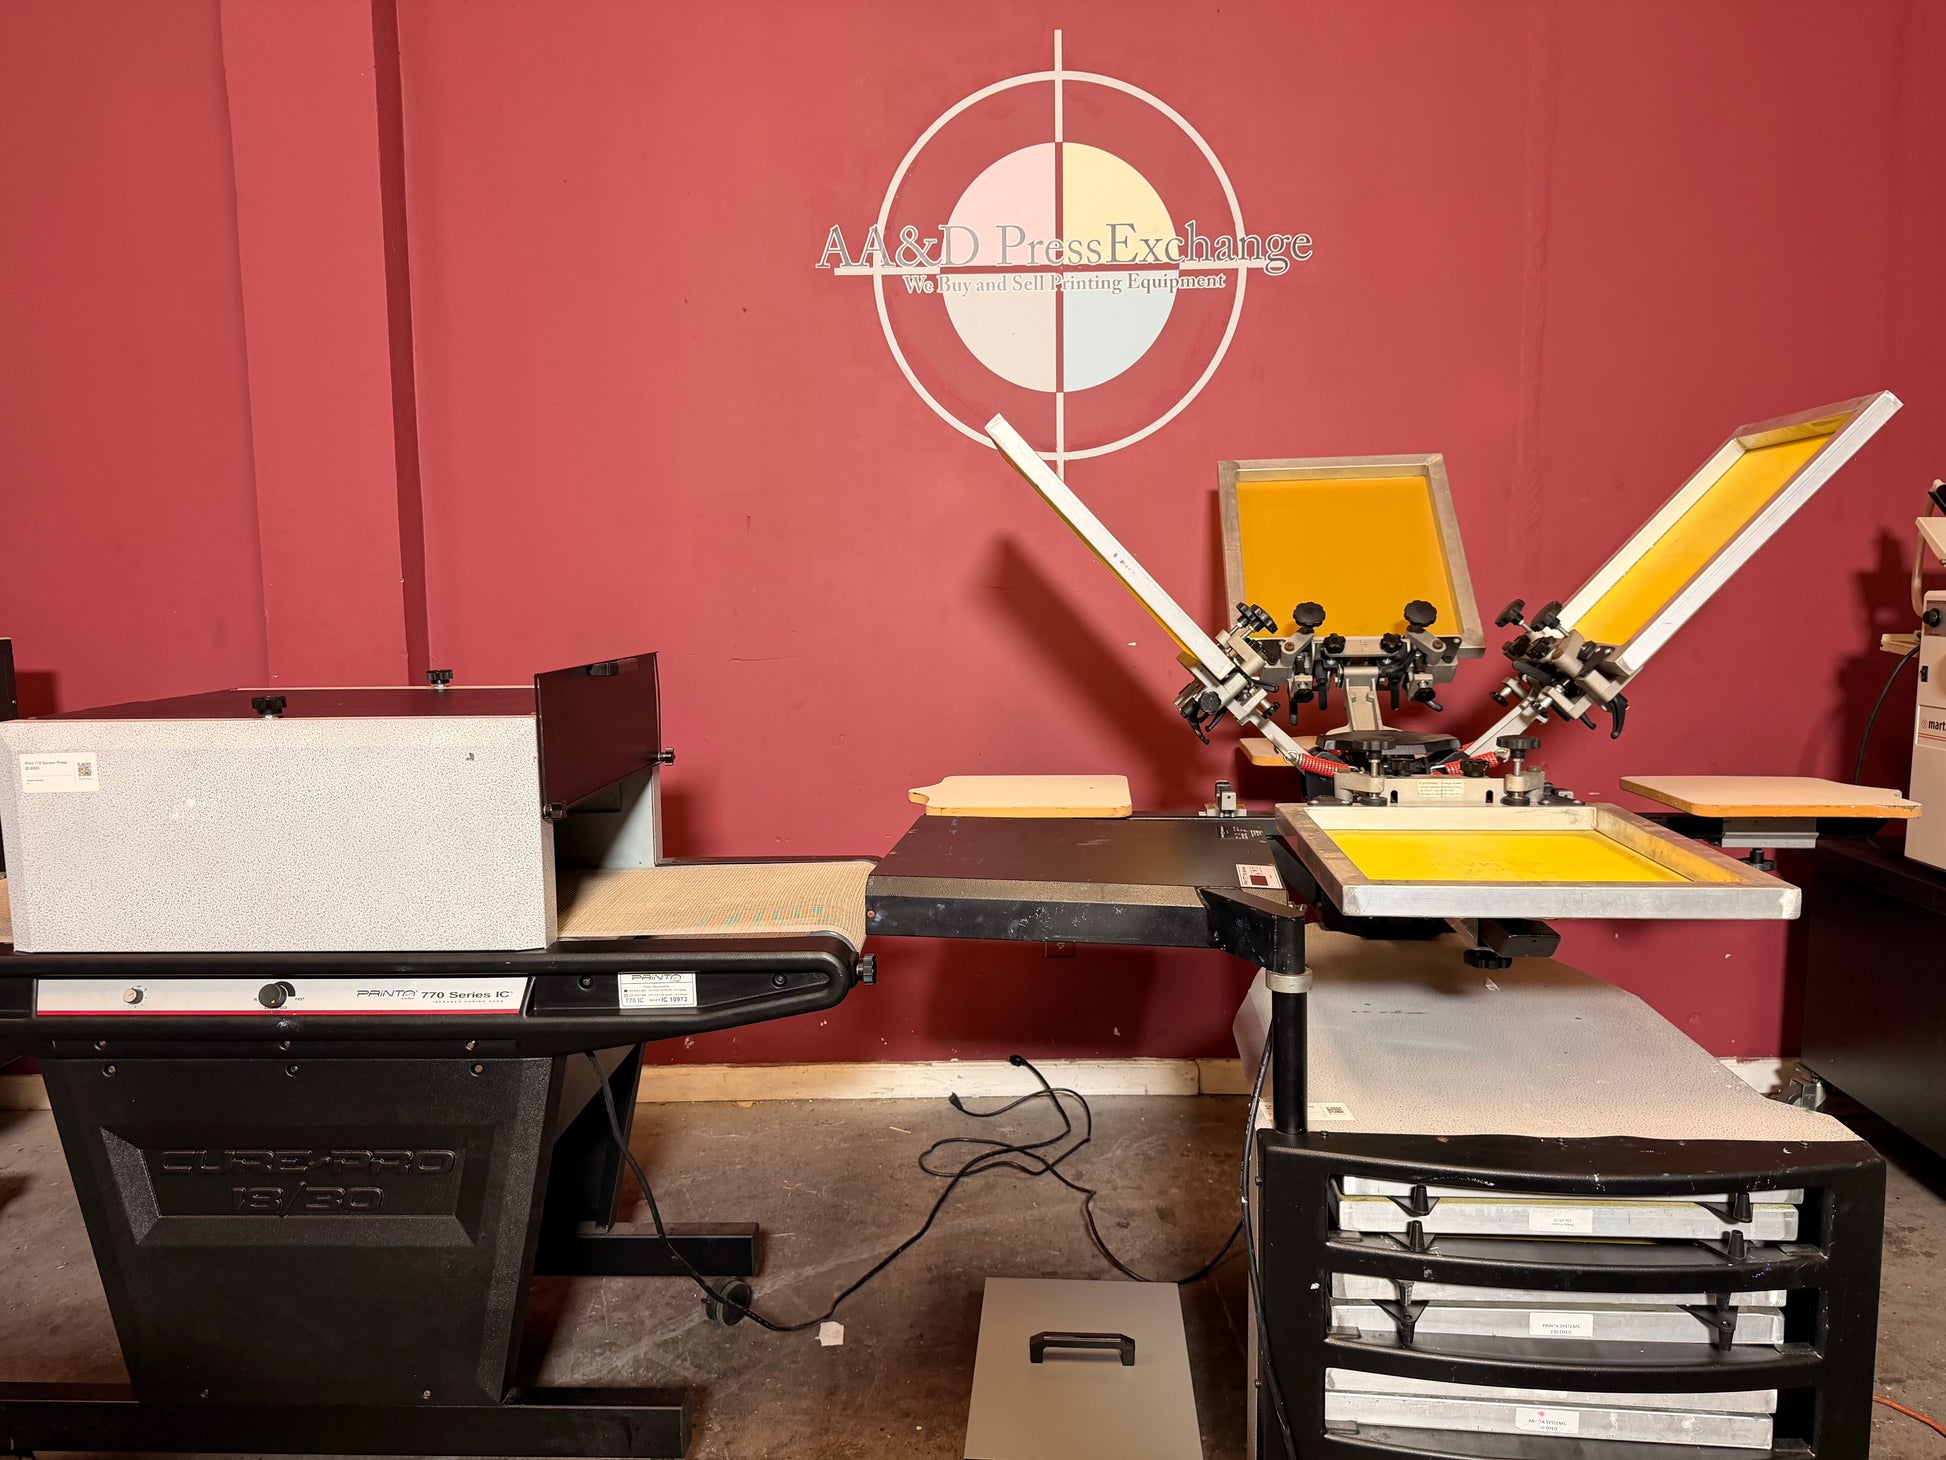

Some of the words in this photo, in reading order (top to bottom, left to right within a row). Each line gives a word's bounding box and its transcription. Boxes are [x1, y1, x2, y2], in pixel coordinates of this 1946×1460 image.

[816, 223, 980, 269] AA&D
[996, 220, 1313, 275] PressExchange
[903, 275, 934, 294] We
[938, 275, 972, 297] Buy
[976, 276, 1007, 291] and
[1012, 275, 1044, 291] Sell
[1050, 274, 1122, 294] Printing
[1127, 272, 1226, 294] Equipment
[421, 991, 445, 999] 770
[449, 991, 491, 999] Series
[231, 1180, 384, 1217] 18/30
